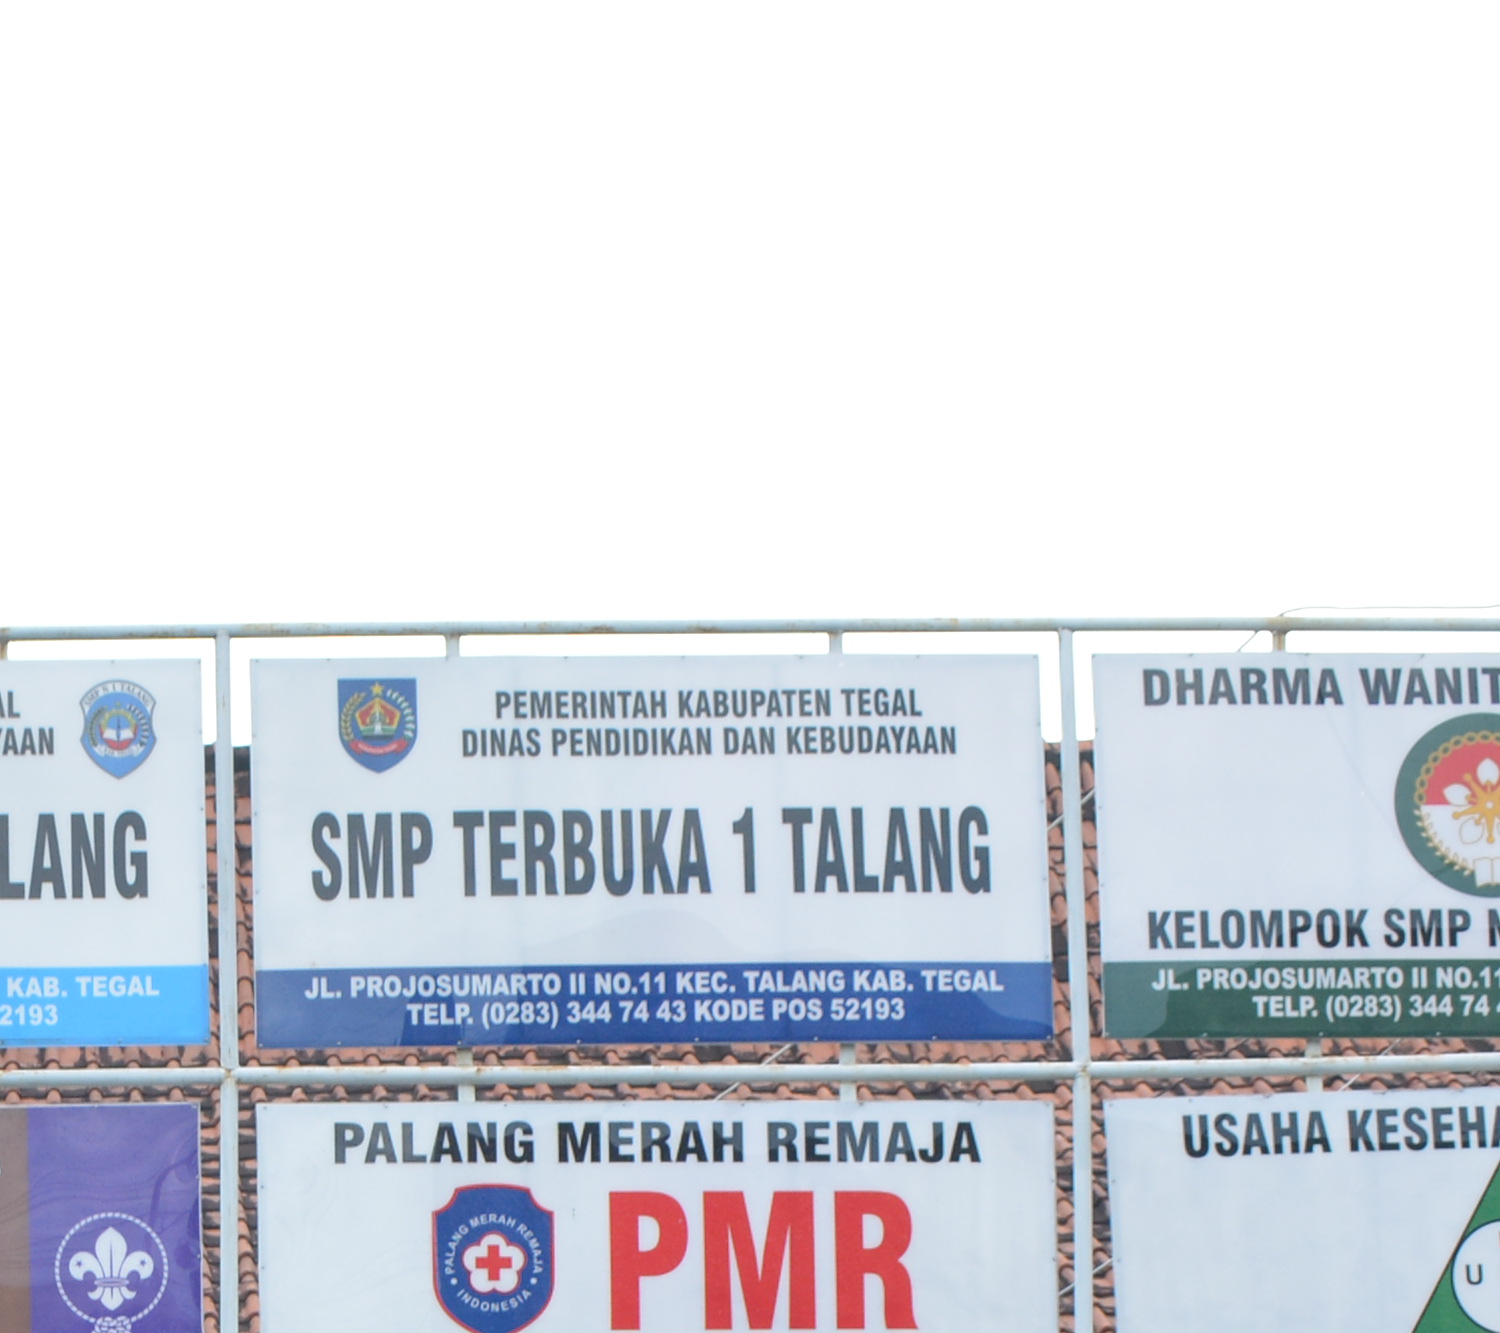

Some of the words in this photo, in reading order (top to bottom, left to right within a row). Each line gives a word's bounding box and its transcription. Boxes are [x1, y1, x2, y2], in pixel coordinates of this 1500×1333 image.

[496, 691, 666, 718] PEMERINTAH
[679, 690, 830, 718] KABUPATEN
[841, 689, 922, 716] TEGAL
[1143, 668, 1343, 706] DHARMA
[463, 728, 540, 756] DINAS
[552, 728, 711, 756] PENDIDIKAN
[724, 727, 775, 754] DAN
[787, 726, 955, 754] KEBUDAYAAN
[312, 812, 432, 901] SMP
[453, 809, 711, 896] TERBUKA
[733, 808, 755, 893] 1
[782, 806, 990, 894] TALANG
[1149, 909, 1369, 949] KELOMPOK
[1385, 909, 1470, 948] SMP
[1252, 996, 1317, 1017] TELP.
[1326, 995, 1401, 1022] (0283)
[1410, 995, 1453, 1016] 344
[1460, 995, 1489, 1016] 74
[335, 1121, 534, 1163] PALANG
[558, 1122, 743, 1162] MERAH
[768, 1122, 981, 1163] REMAJA
[1183, 1112, 1331, 1158] USAHA
[445, 1224, 469, 1275] PALANG
[469, 1213, 517, 1228] MERAH
[517, 1223, 543, 1274] REMAJA
[609, 1191, 917, 1330] PMR
[457, 1289, 532, 1312] INDONESIA
